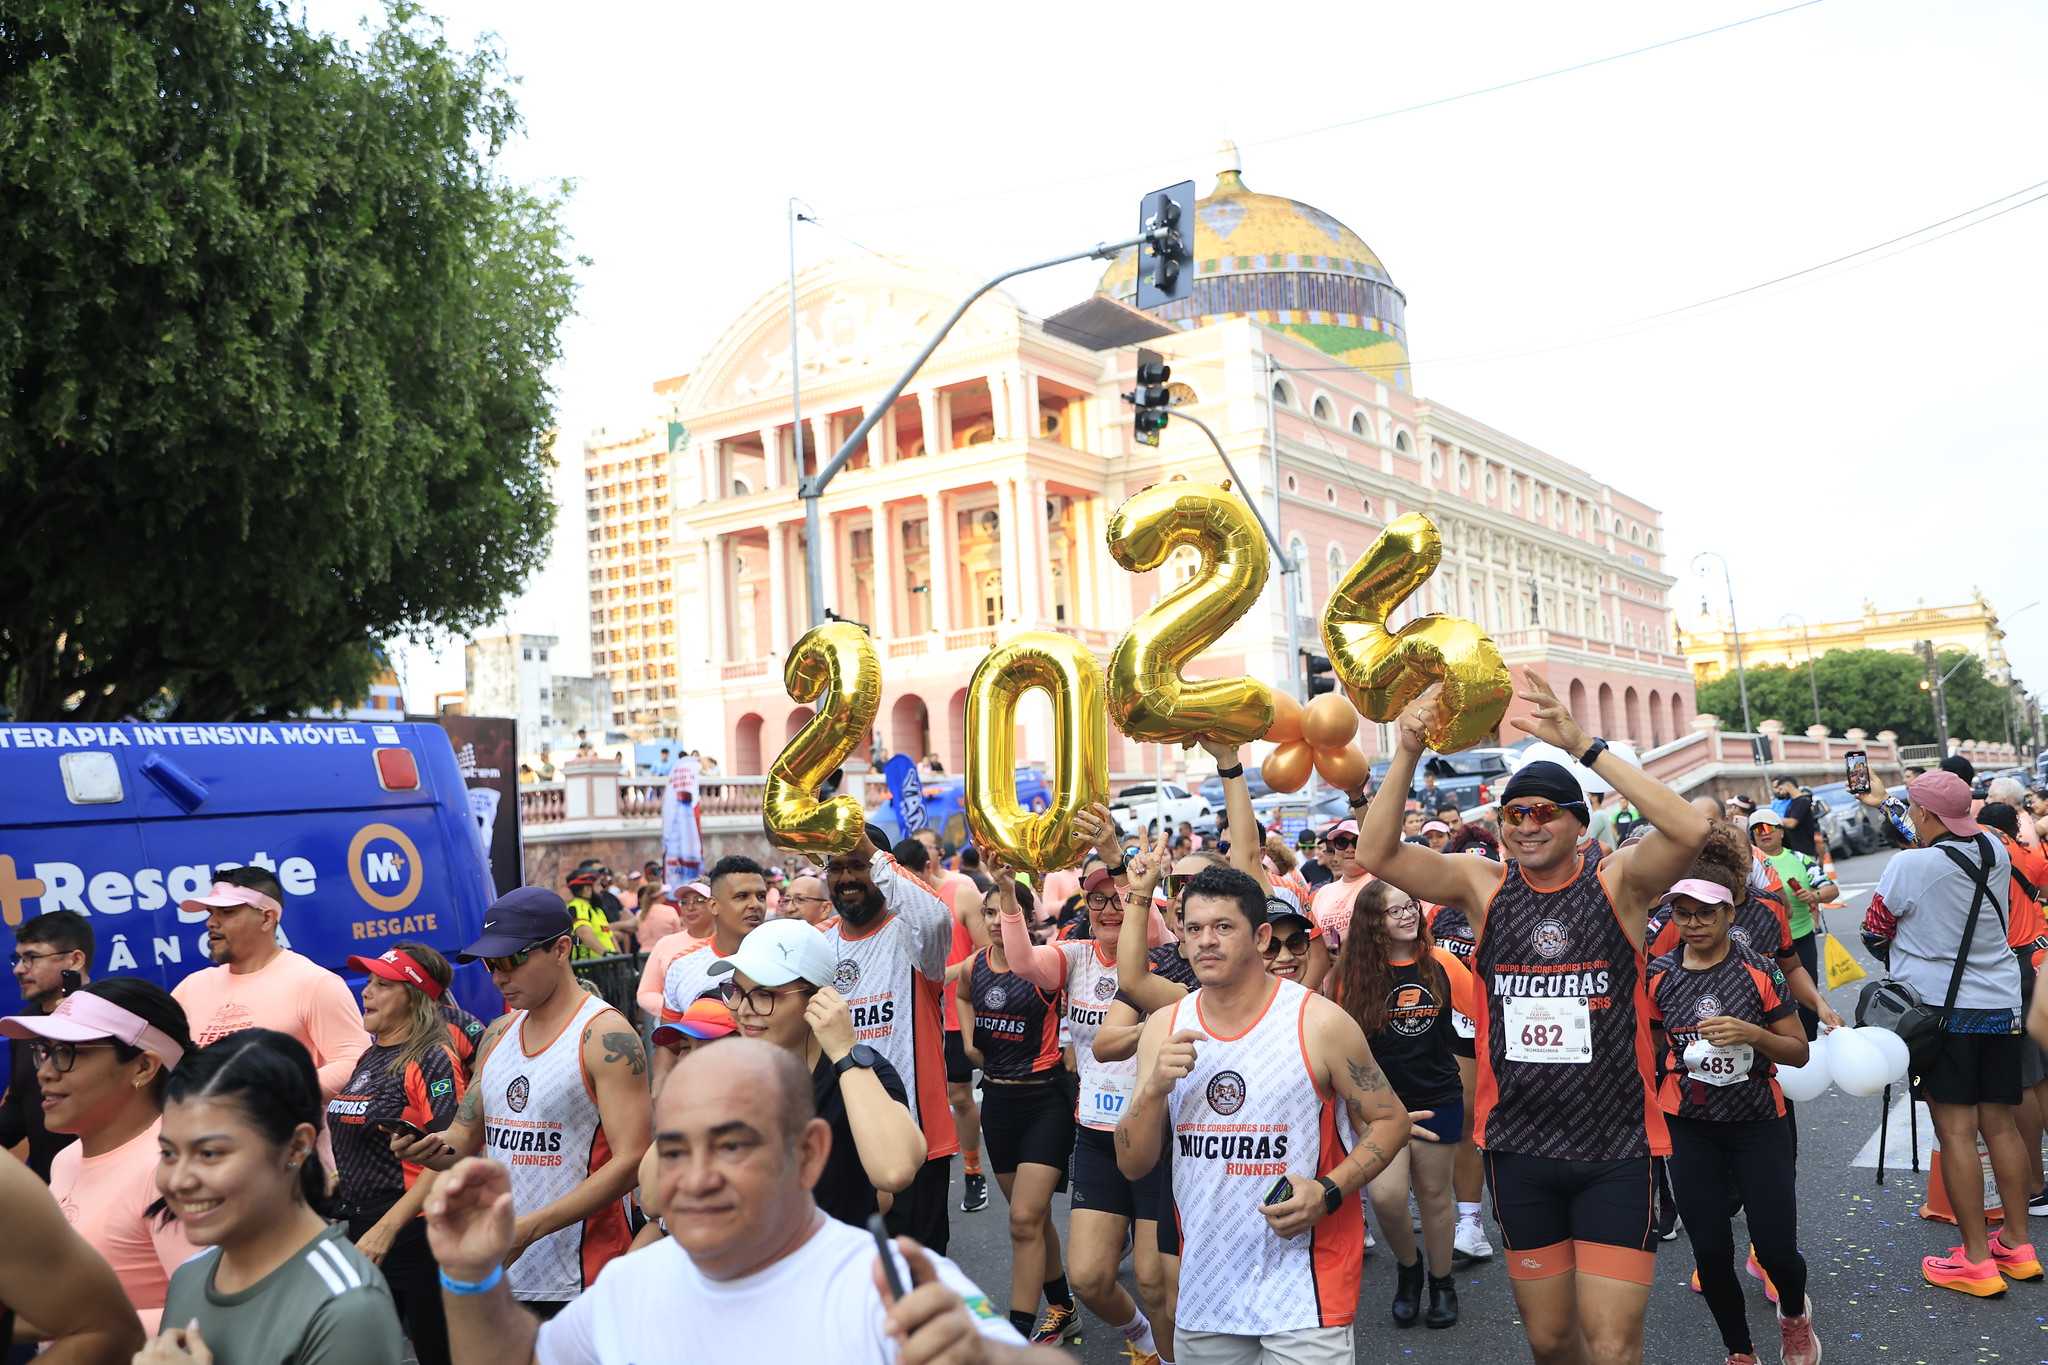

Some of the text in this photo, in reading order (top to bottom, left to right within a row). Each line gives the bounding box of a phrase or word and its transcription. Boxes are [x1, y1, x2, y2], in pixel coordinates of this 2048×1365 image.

[0, 724, 367, 748] TERAPIA INTENSIVA MÓVEL
[352, 913, 438, 940] RESGATE
[1495, 963, 1519, 972] GRUPO
[1532, 963, 1581, 973] CORREDORES
[1582, 962, 1591, 970] DE
[1494, 971, 1609, 997] MUCURAS
[1396, 989, 1421, 1007] 8
[1521, 1024, 1563, 1046] 682
[1551, 1064, 1577, 1092] RUNNERS
[1700, 1057, 1735, 1074] 683
[1558, 1075, 1584, 1102] MUCURAS
[1094, 1093, 1125, 1112] 107
[1568, 1102, 1592, 1127] MUCURAS
[1197, 1124, 1205, 1132] DE
[1207, 1124, 1257, 1133] CORREDORES
[1273, 1124, 1288, 1132] RUA
[511, 1153, 562, 1167] RUNNERS
[1179, 1135, 1288, 1160] MUCURAS
[1225, 1162, 1288, 1176] RUNNERS
[1193, 1202, 1240, 1260] MUCURAS RUNNERS
[1223, 1216, 1247, 1243] MUCURAS
[1196, 1246, 1219, 1276] RUNNERS
[1202, 1232, 1249, 1288] MUCURAS RUNNERS
[1205, 1275, 1229, 1305] RUNNERS
[1212, 1259, 1259, 1317] MUCURAS RUNNERS
